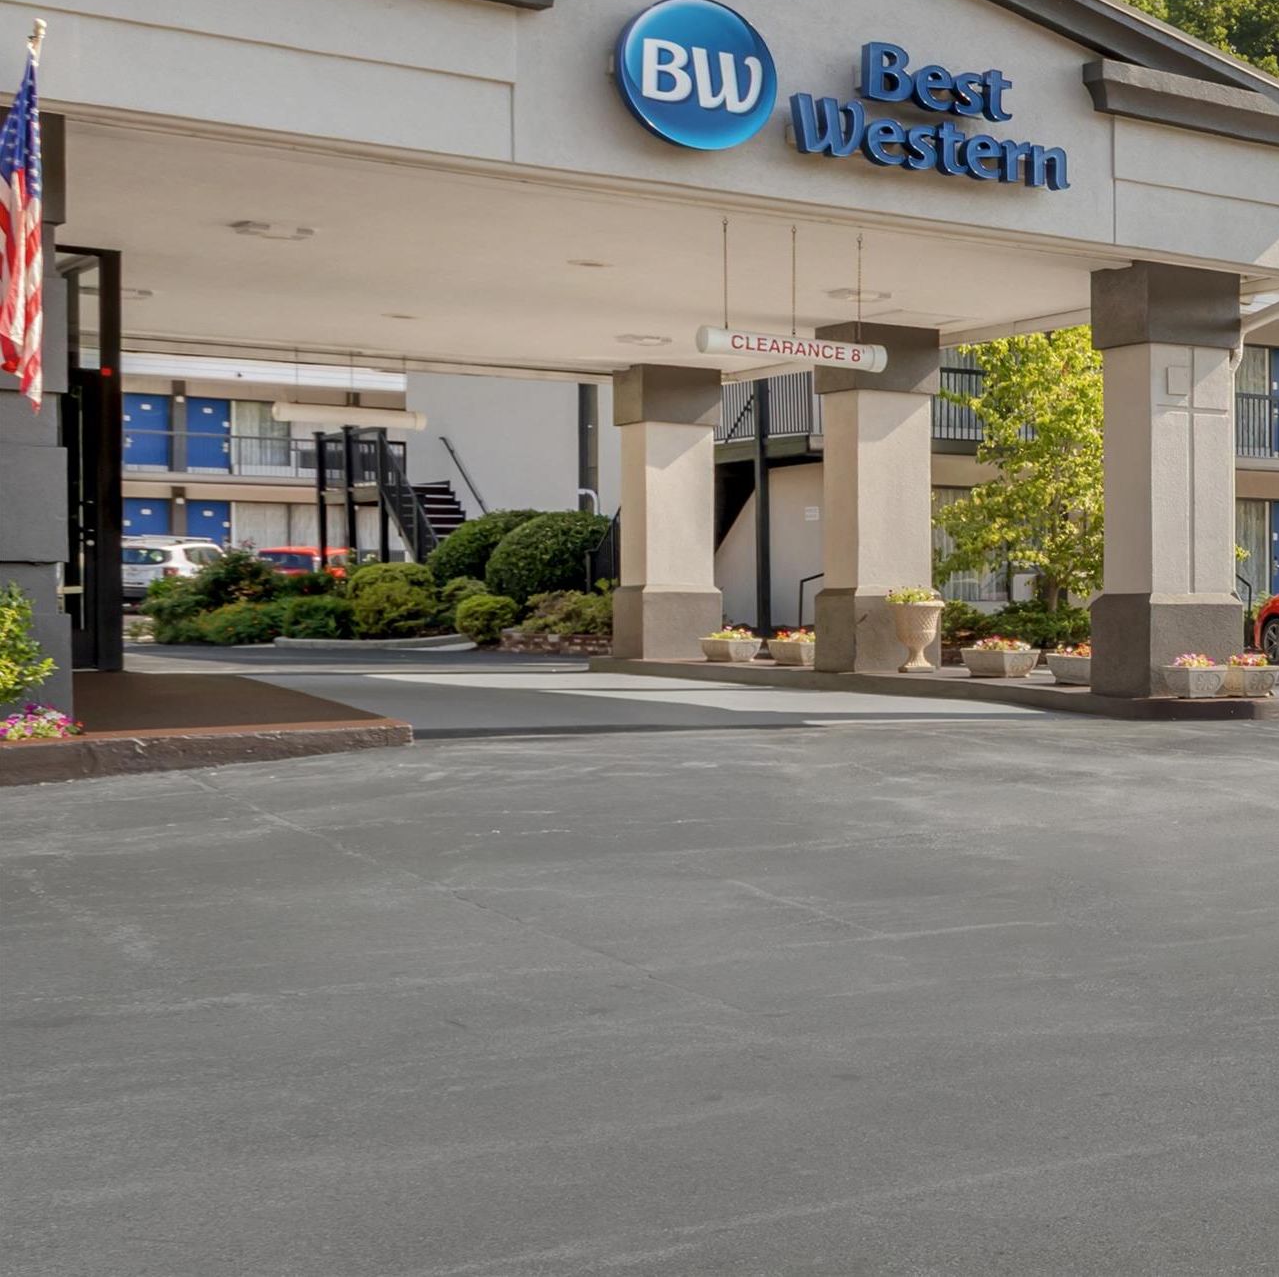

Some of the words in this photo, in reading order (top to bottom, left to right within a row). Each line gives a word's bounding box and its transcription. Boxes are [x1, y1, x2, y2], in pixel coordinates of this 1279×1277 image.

[641, 37, 763, 114] BW
[861, 41, 1013, 122] Best
[788, 92, 1071, 191] Western
[731, 334, 845, 361] CLEARANCE
